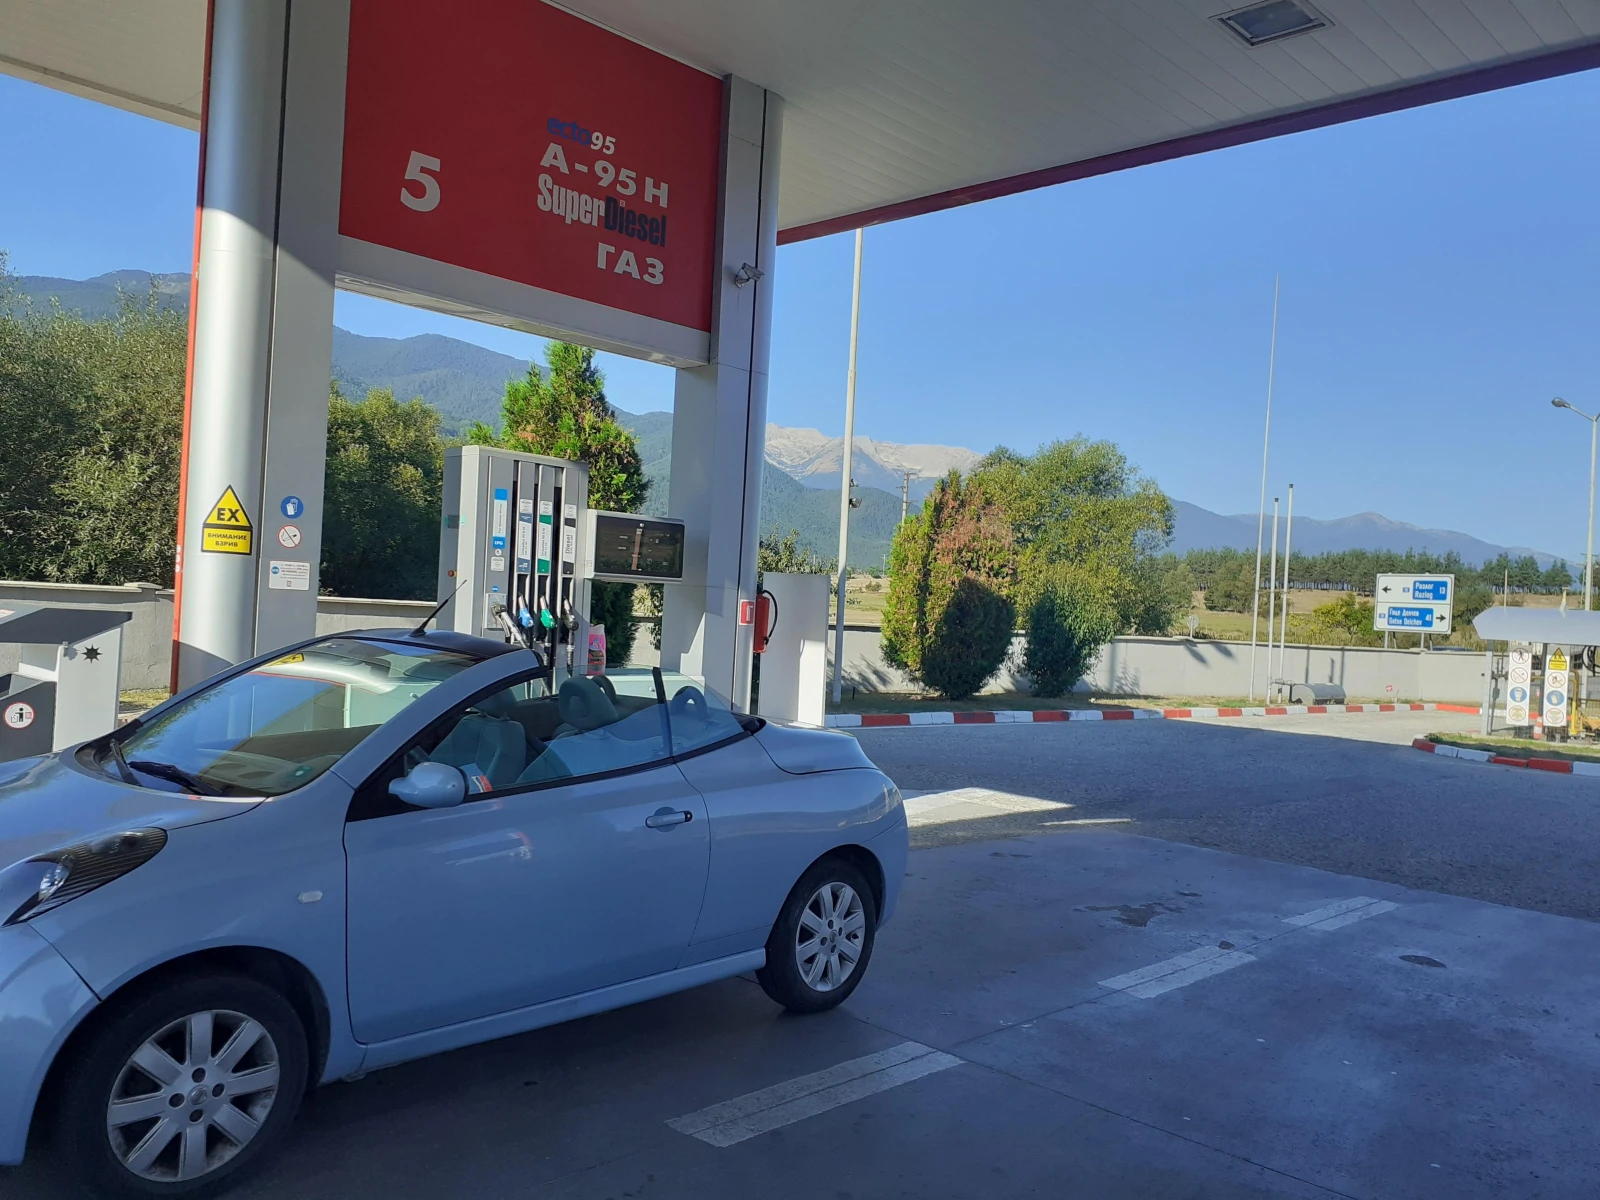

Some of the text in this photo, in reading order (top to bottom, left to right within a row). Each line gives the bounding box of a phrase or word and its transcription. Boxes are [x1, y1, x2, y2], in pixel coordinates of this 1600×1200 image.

[400, 150, 441, 212] 5
[596, 242, 665, 285] ГАЗ
[216, 507, 240, 523] EX
[207, 532, 248, 541] ВНИМАНИЕ
[1415, 582, 1434, 590] Разлог
[1439, 586, 1446, 594] 13
[1414, 591, 1433, 600] Razlog
[1425, 614, 1432, 622] 41
